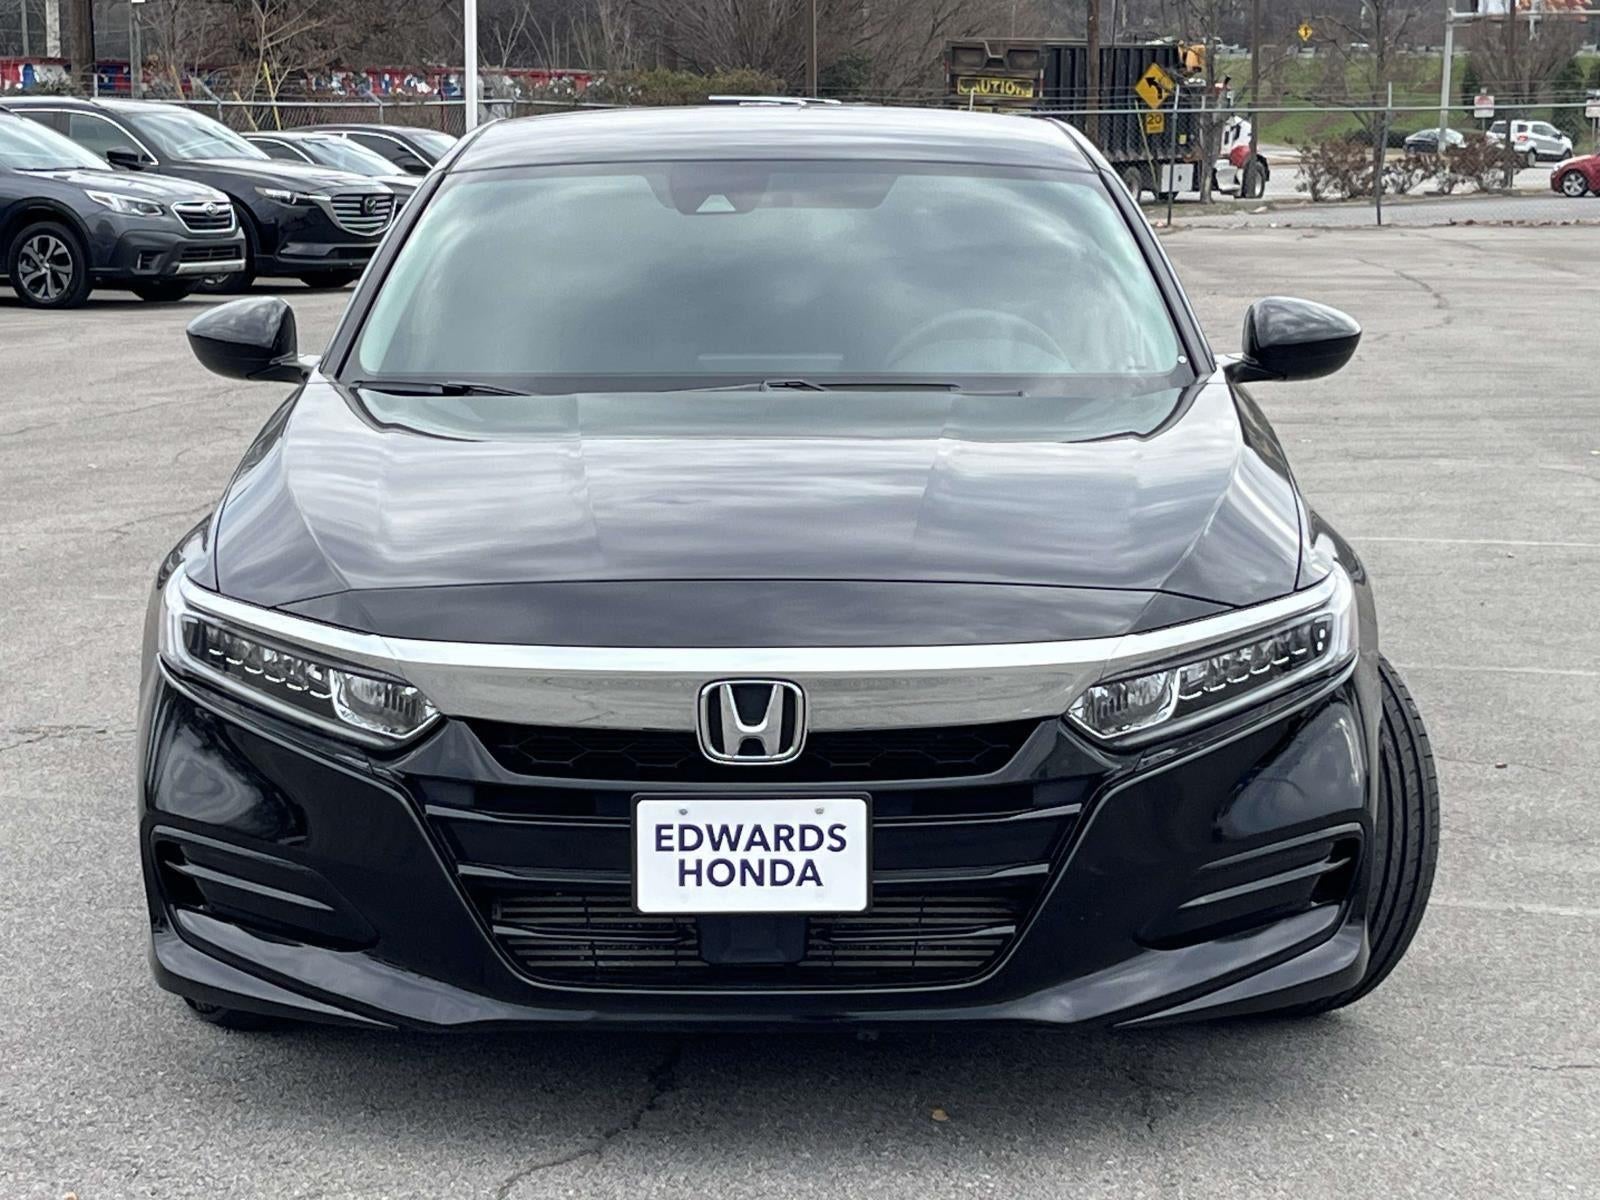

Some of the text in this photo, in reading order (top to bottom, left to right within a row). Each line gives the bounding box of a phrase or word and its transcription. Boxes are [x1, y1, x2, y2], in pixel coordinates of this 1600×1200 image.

[1147, 112, 1162, 125] 20
[655, 823, 847, 852] EDWARDS
[678, 858, 824, 887] HONDA
